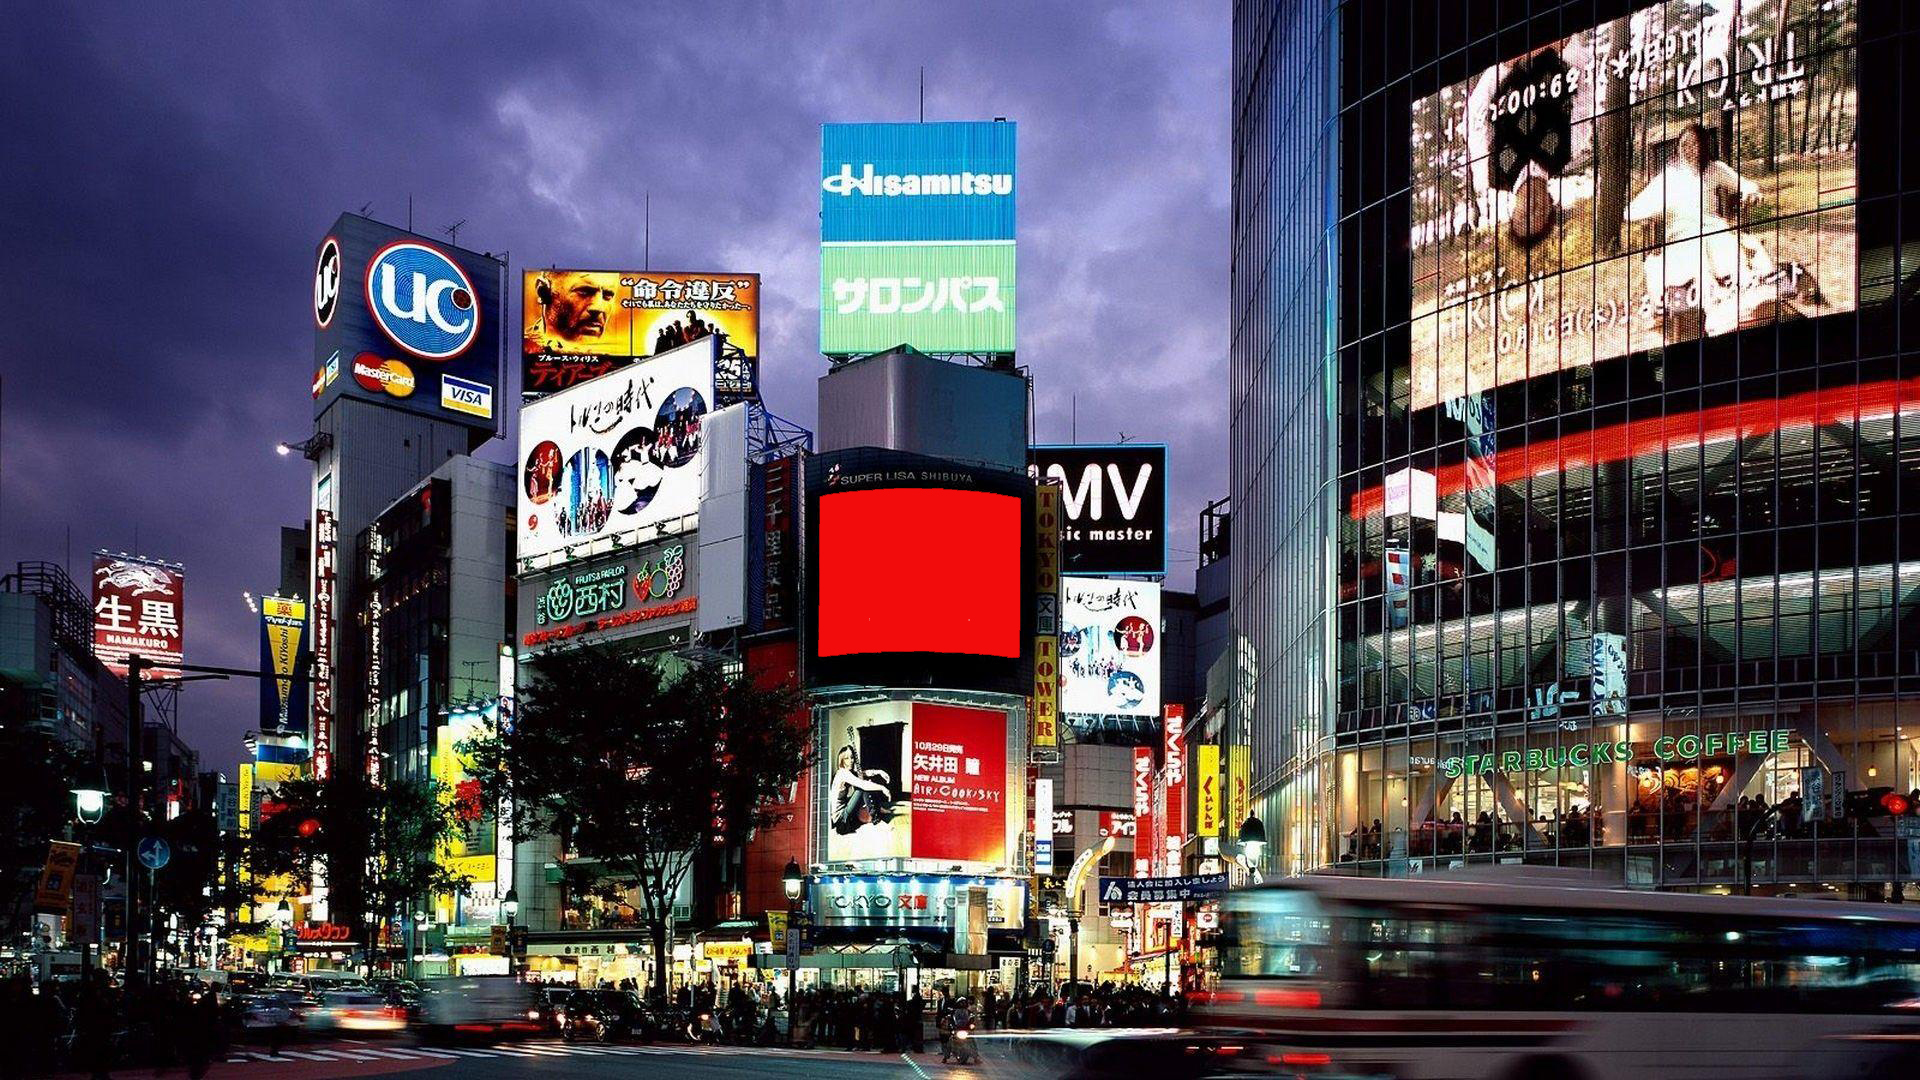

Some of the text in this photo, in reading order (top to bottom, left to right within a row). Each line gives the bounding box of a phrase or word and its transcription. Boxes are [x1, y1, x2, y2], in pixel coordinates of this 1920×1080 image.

[821, 164, 1012, 196] Hisamitsu
[832, 276, 1005, 314] サロンパス
[353, 362, 416, 388] MasterCard
[450, 387, 484, 407] VISA
[840, 471, 974, 485] SUPER LISA SHIBUYA
[1038, 491, 1055, 587] TOKYO
[1088, 527, 1153, 541] master
[575, 578, 625, 616] 西村
[95, 594, 179, 638] 生黒
[106, 633, 169, 650] NAMAKURO
[277, 667, 290, 725] Matsumoo
[1036, 642, 1055, 737] TOWER
[913, 752, 959, 774] 矢井田
[1444, 740, 1635, 779] STARBUCKS
[1653, 729, 1790, 760] COFFEE
[914, 774, 930, 783] NEW
[1127, 888, 1191, 901] 会員募集中
